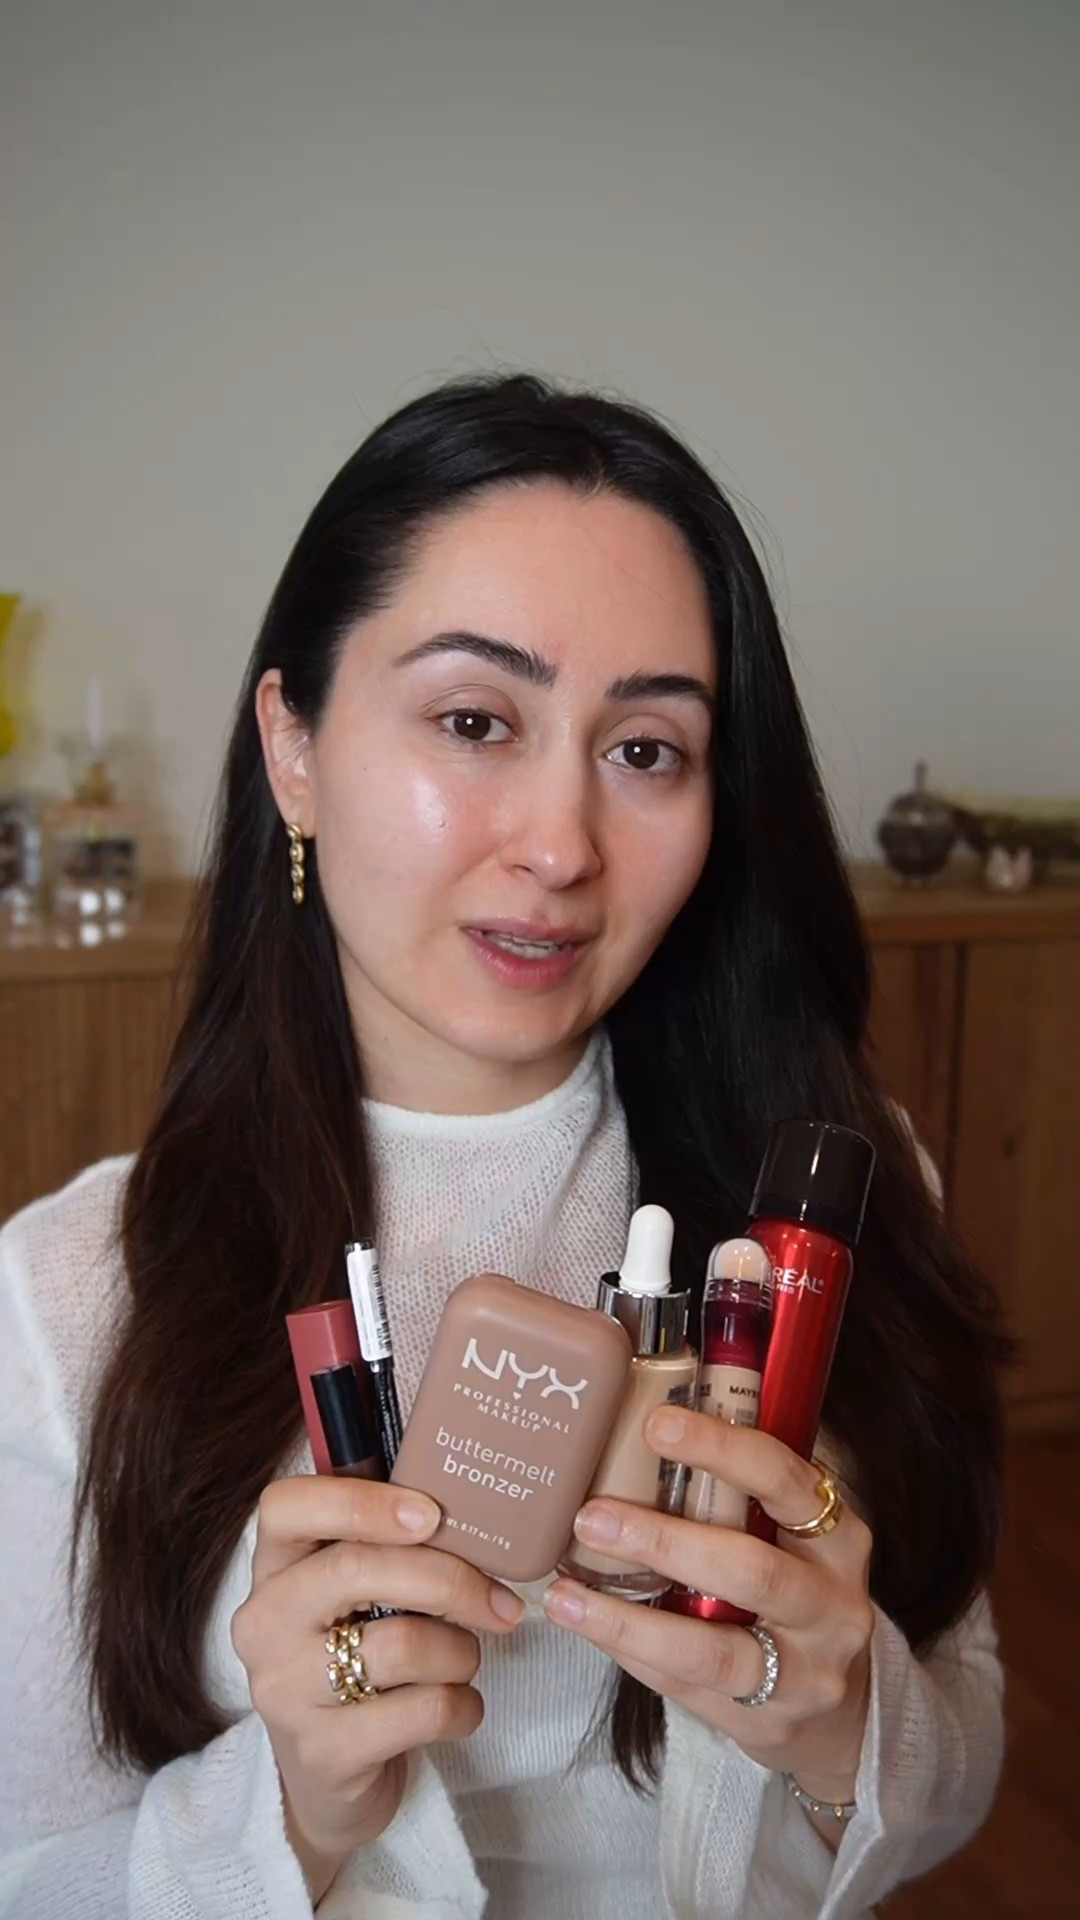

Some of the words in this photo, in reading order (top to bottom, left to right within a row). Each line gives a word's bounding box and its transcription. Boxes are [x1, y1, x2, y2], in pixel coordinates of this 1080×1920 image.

[461, 1337, 588, 1410] NYX
[453, 1383, 570, 1434] PROFESSIONAL
[477, 1403, 541, 1432] MAKEUP
[436, 1426, 556, 1487] buttermelt
[443, 1454, 534, 1500] bronzer
